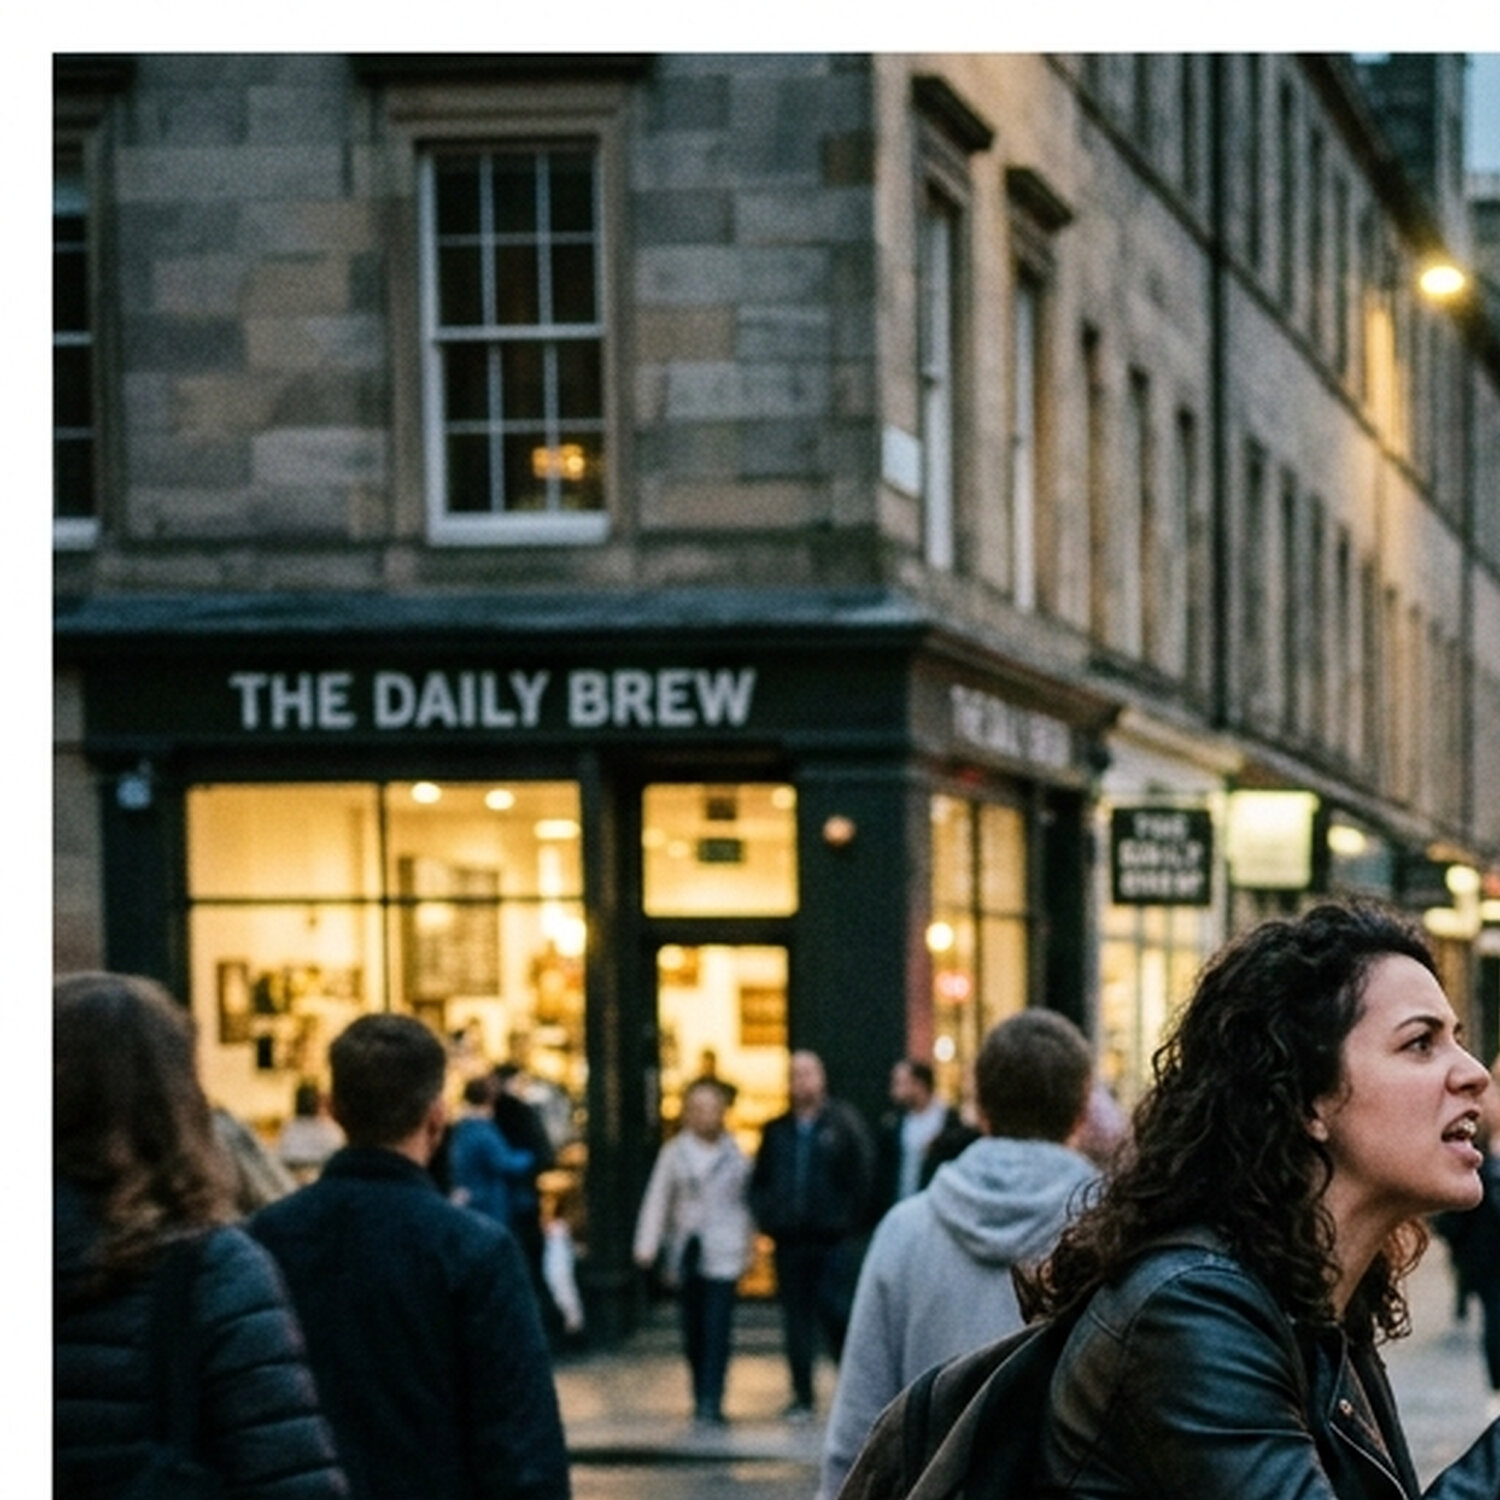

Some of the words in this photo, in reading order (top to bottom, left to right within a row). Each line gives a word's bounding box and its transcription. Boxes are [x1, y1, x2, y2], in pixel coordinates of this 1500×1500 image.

[229, 672, 355, 729] THE
[374, 672, 549, 729] DAILY
[567, 668, 757, 728] BREW
